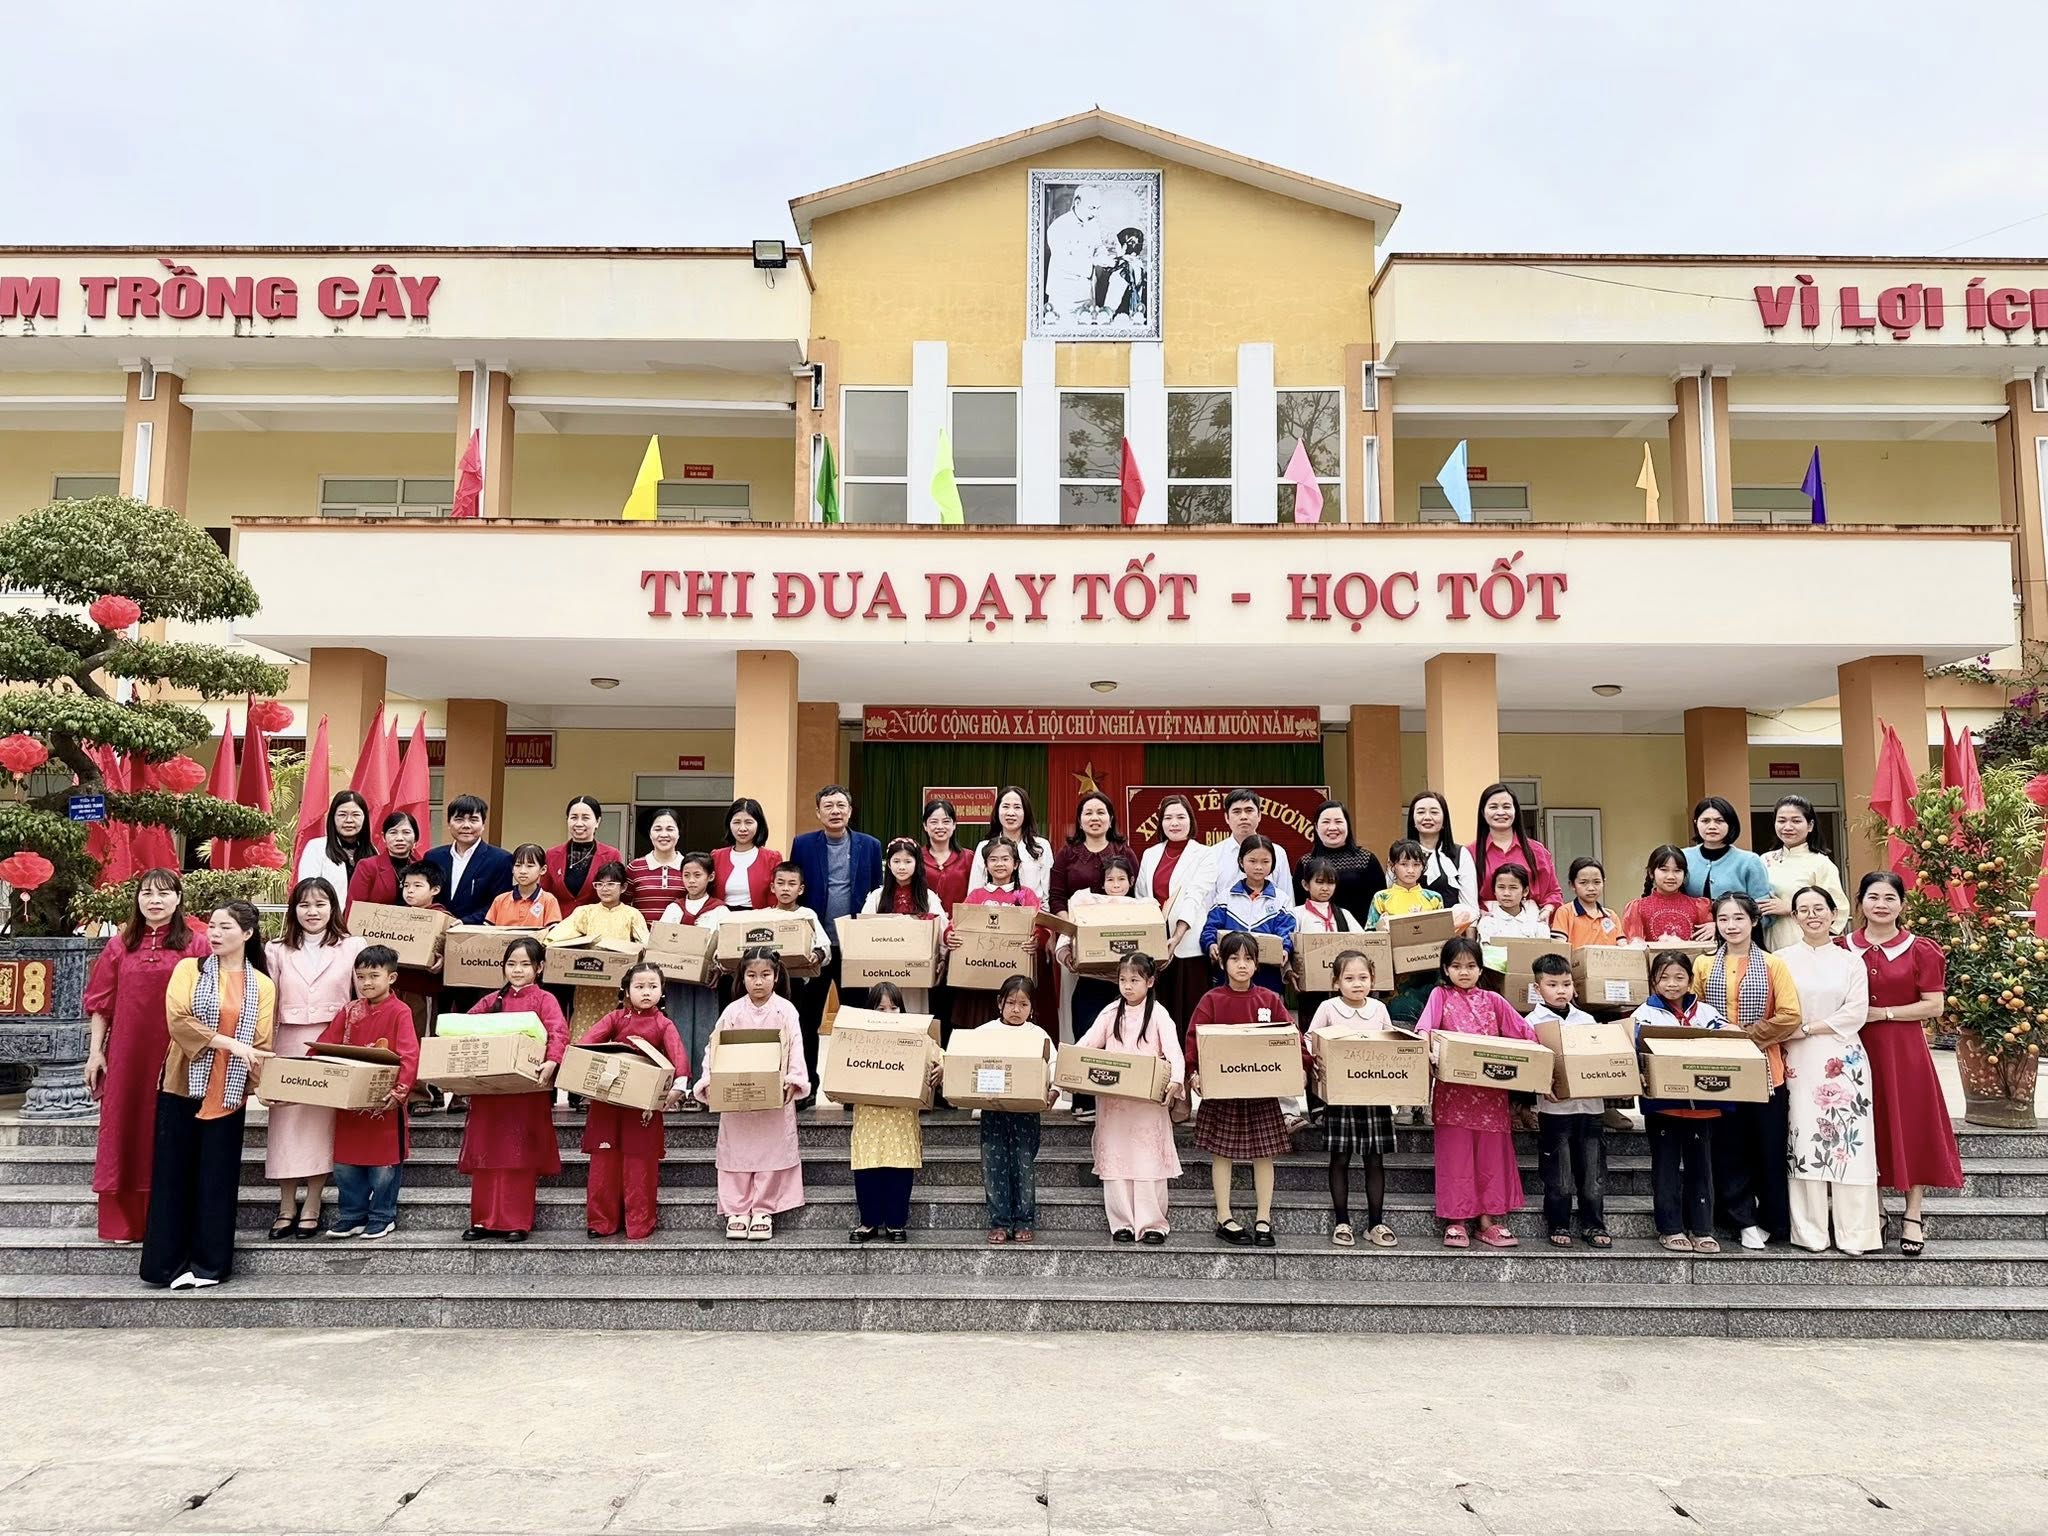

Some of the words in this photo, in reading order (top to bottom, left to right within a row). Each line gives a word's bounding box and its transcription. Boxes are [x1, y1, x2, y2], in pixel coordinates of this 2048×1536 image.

[80, 259, 299, 318] TRỒNG
[318, 264, 441, 318] CÂY
[1753, 275, 1820, 329] VÌ
[1839, 283, 1944, 340] LỢI
[640, 570, 755, 618] THI
[772, 570, 907, 619] ĐUA
[924, 572, 1057, 632] DẠY
[1073, 552, 1198, 621] TỐT
[1286, 571, 1420, 632] HỌC
[1437, 550, 1568, 621] TỐT
[887, 708, 938, 740] NƯỚC
[941, 710, 979, 740] CỘNG
[981, 710, 1010, 735] HÒA
[1013, 710, 1036, 735] XÃ
[1038, 710, 1067, 740] HỘI
[1067, 710, 1096, 735] CHỦ
[1099, 710, 1146, 735] NGHĨA
[1147, 710, 1182, 740] VIỆT
[1183, 715, 1216, 735] NAM
[1218, 711, 1261, 735] MUÔN
[1262, 710, 1295, 735] NĂM
[362, 929, 415, 942] LocknLock
[965, 957, 1017, 968] LocknLock
[1406, 954, 1440, 963] LocknLock
[862, 969, 911, 977] LocknLock
[846, 1058, 905, 1071] LocknLock
[1220, 1062, 1282, 1073] LocknLock
[1347, 1069, 1409, 1079] LocknLock
[1580, 1070, 1628, 1079] LocknLock
[281, 1075, 328, 1088] LocknLock
